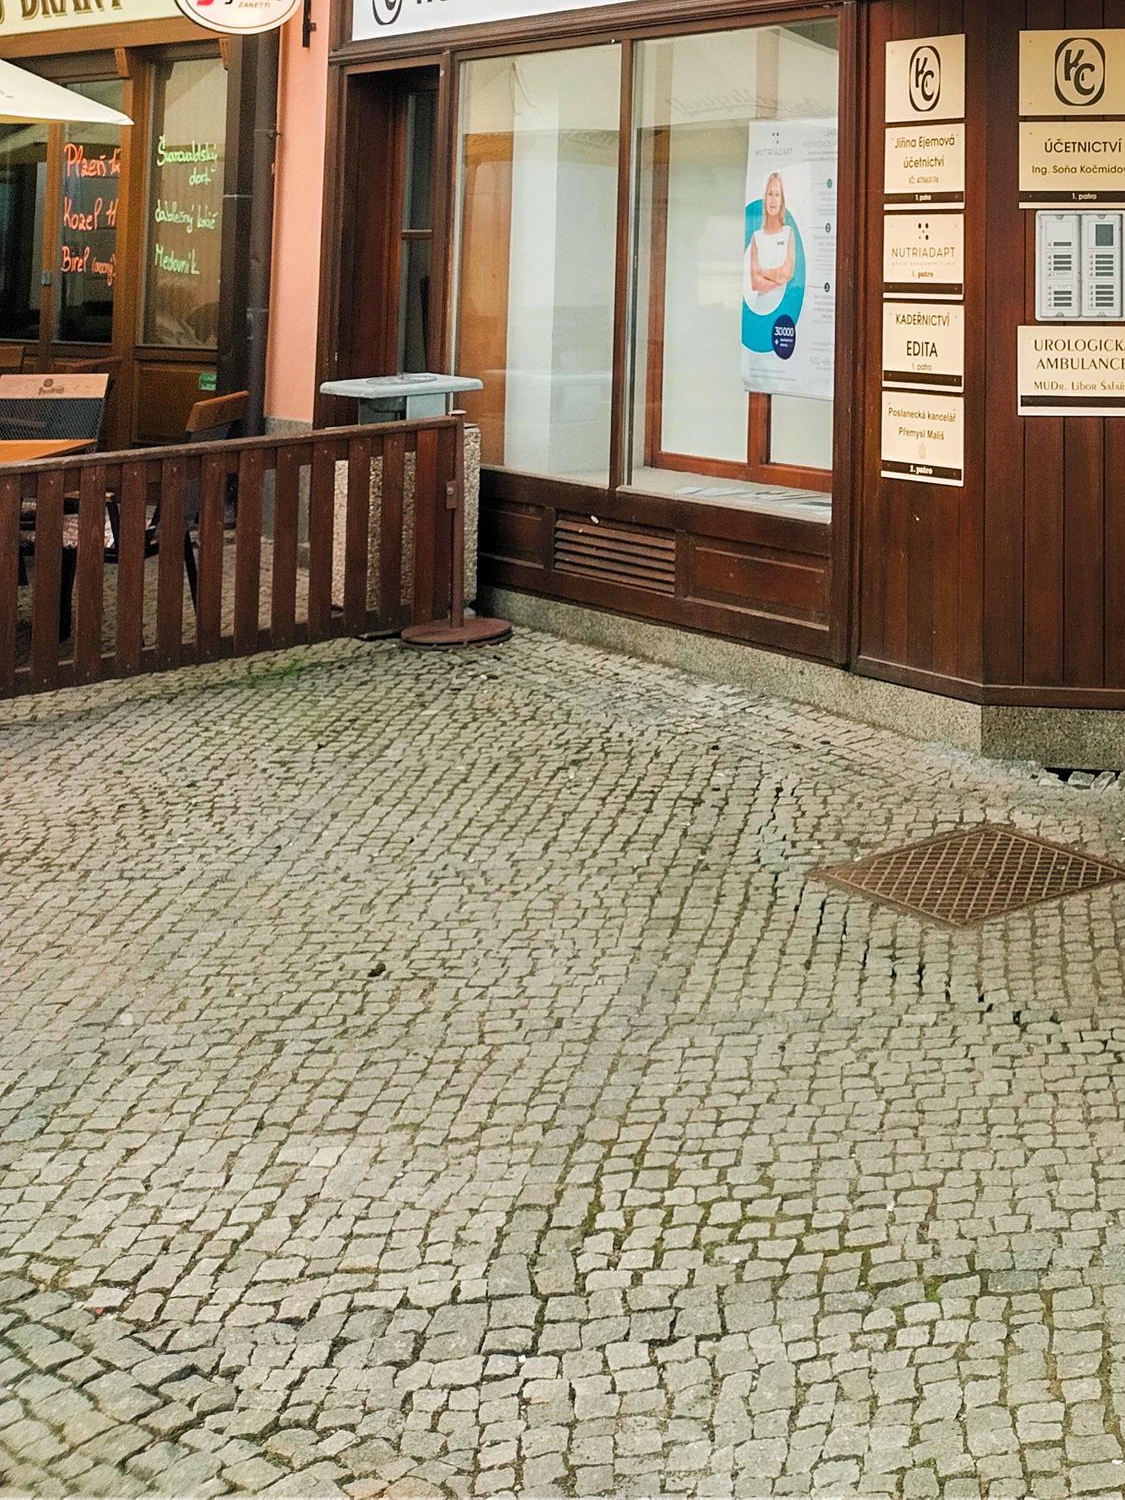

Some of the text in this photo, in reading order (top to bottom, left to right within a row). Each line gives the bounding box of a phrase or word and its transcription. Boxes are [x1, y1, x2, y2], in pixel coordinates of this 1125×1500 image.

[1044, 138, 1122, 154] ÚČETNICTVÍ
[903, 155, 945, 169] účetnictví
[1032, 165, 1050, 176] Ing.
[1052, 164, 1078, 175] Soňa
[1078, 193, 1097, 202] patro
[63, 197, 102, 231] Kozel
[891, 247, 956, 258] NUTRIADAPT
[895, 311, 951, 328] KADEŘNICTVÍ
[906, 340, 938, 358] EDITA
[888, 407, 926, 420] Poslanecká
